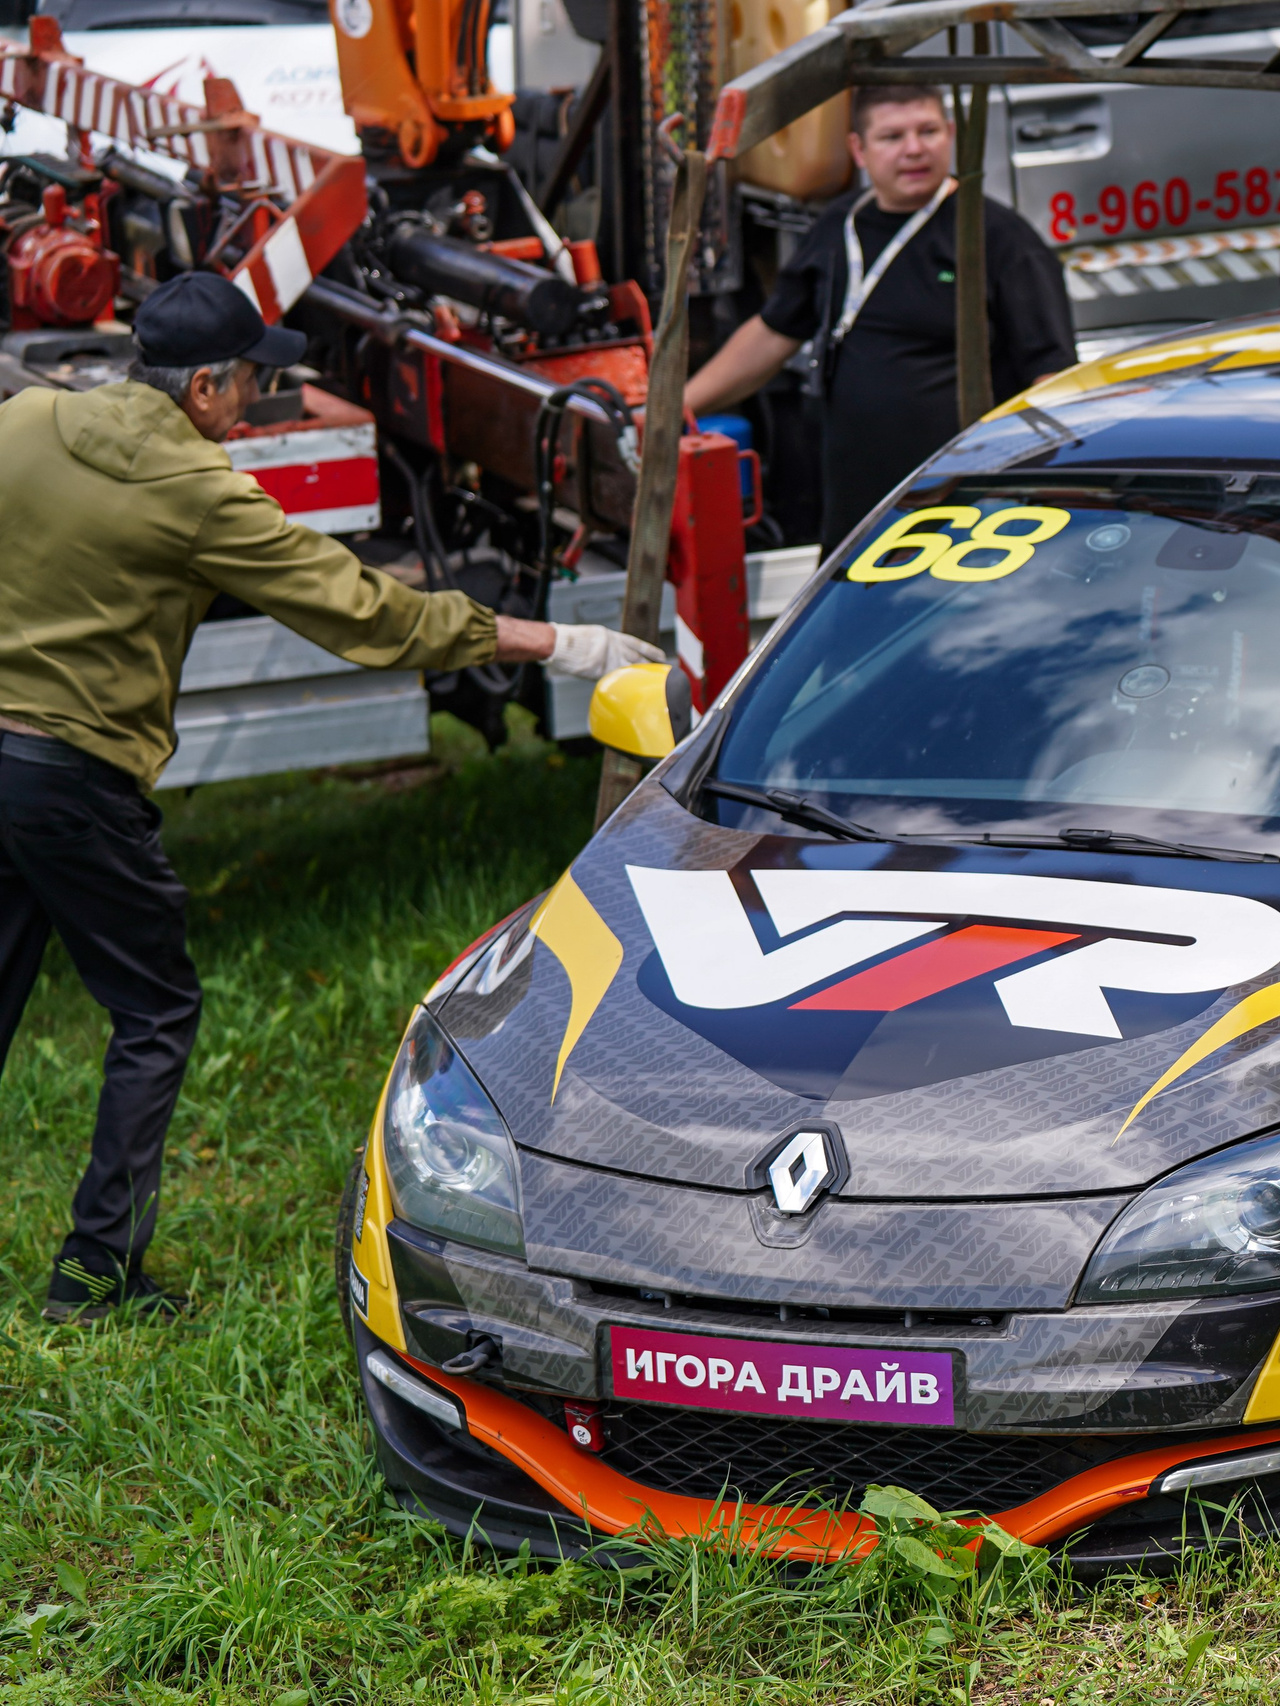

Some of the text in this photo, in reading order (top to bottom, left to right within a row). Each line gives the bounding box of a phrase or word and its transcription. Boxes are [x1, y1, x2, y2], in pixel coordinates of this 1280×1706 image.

[846, 505, 1072, 583] 68
[625, 1348, 941, 1405] ИГОРА ДРАЙВ
